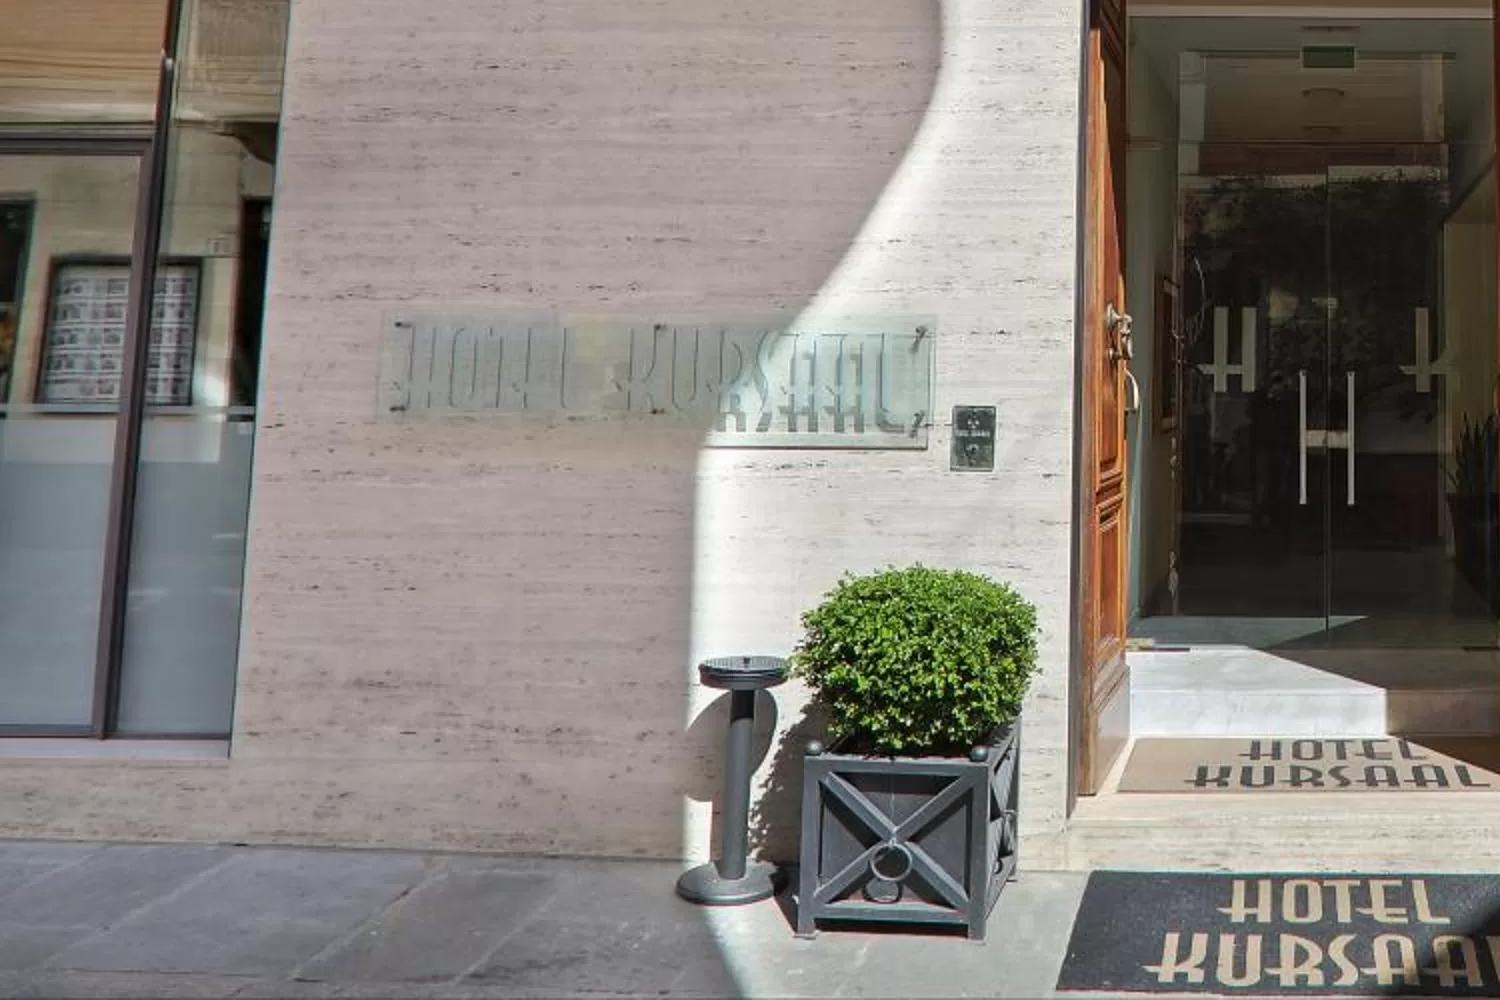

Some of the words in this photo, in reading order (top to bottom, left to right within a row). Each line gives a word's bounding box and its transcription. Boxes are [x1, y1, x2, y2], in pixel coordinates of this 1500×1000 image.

[1237, 739, 1429, 761] HOTEL
[1184, 765, 1491, 788] KURSAAL
[1217, 879, 1450, 924] HOTEL
